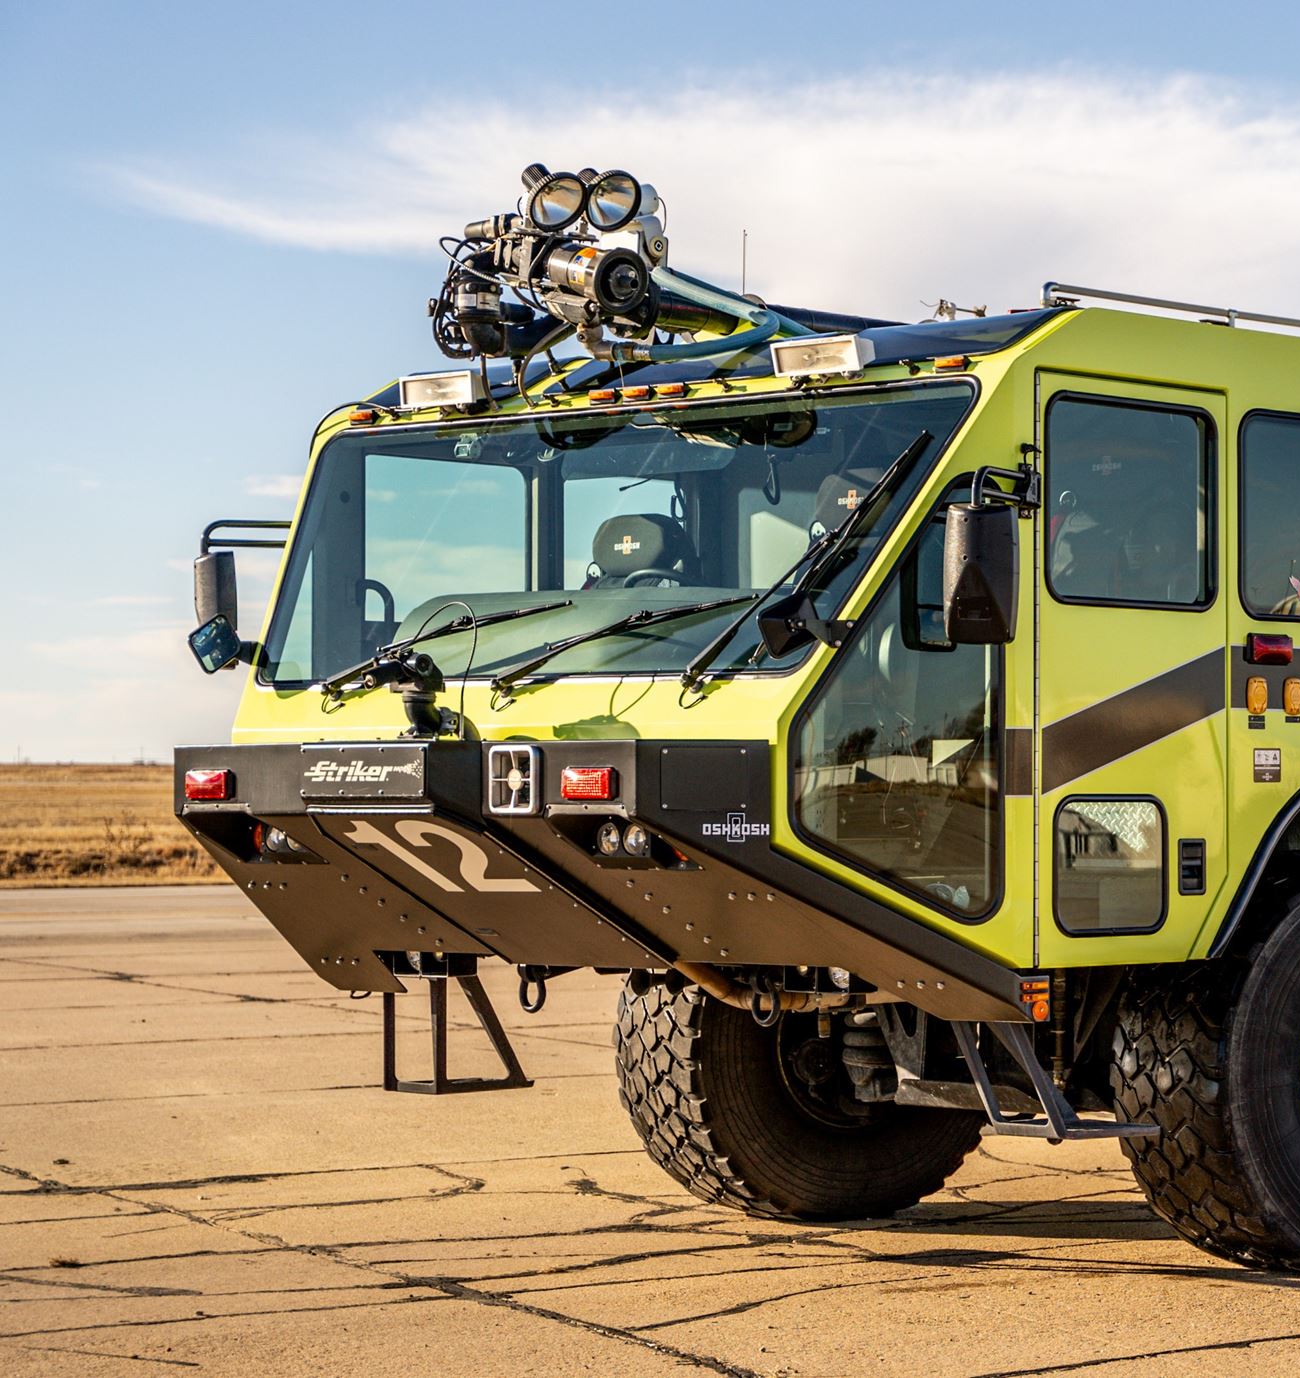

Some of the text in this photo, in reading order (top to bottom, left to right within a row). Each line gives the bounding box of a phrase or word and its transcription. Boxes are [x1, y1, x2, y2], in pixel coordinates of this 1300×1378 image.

[303, 760, 391, 782] Striker
[702, 823, 770, 836] OSHKOSH
[343, 819, 542, 893] 12
